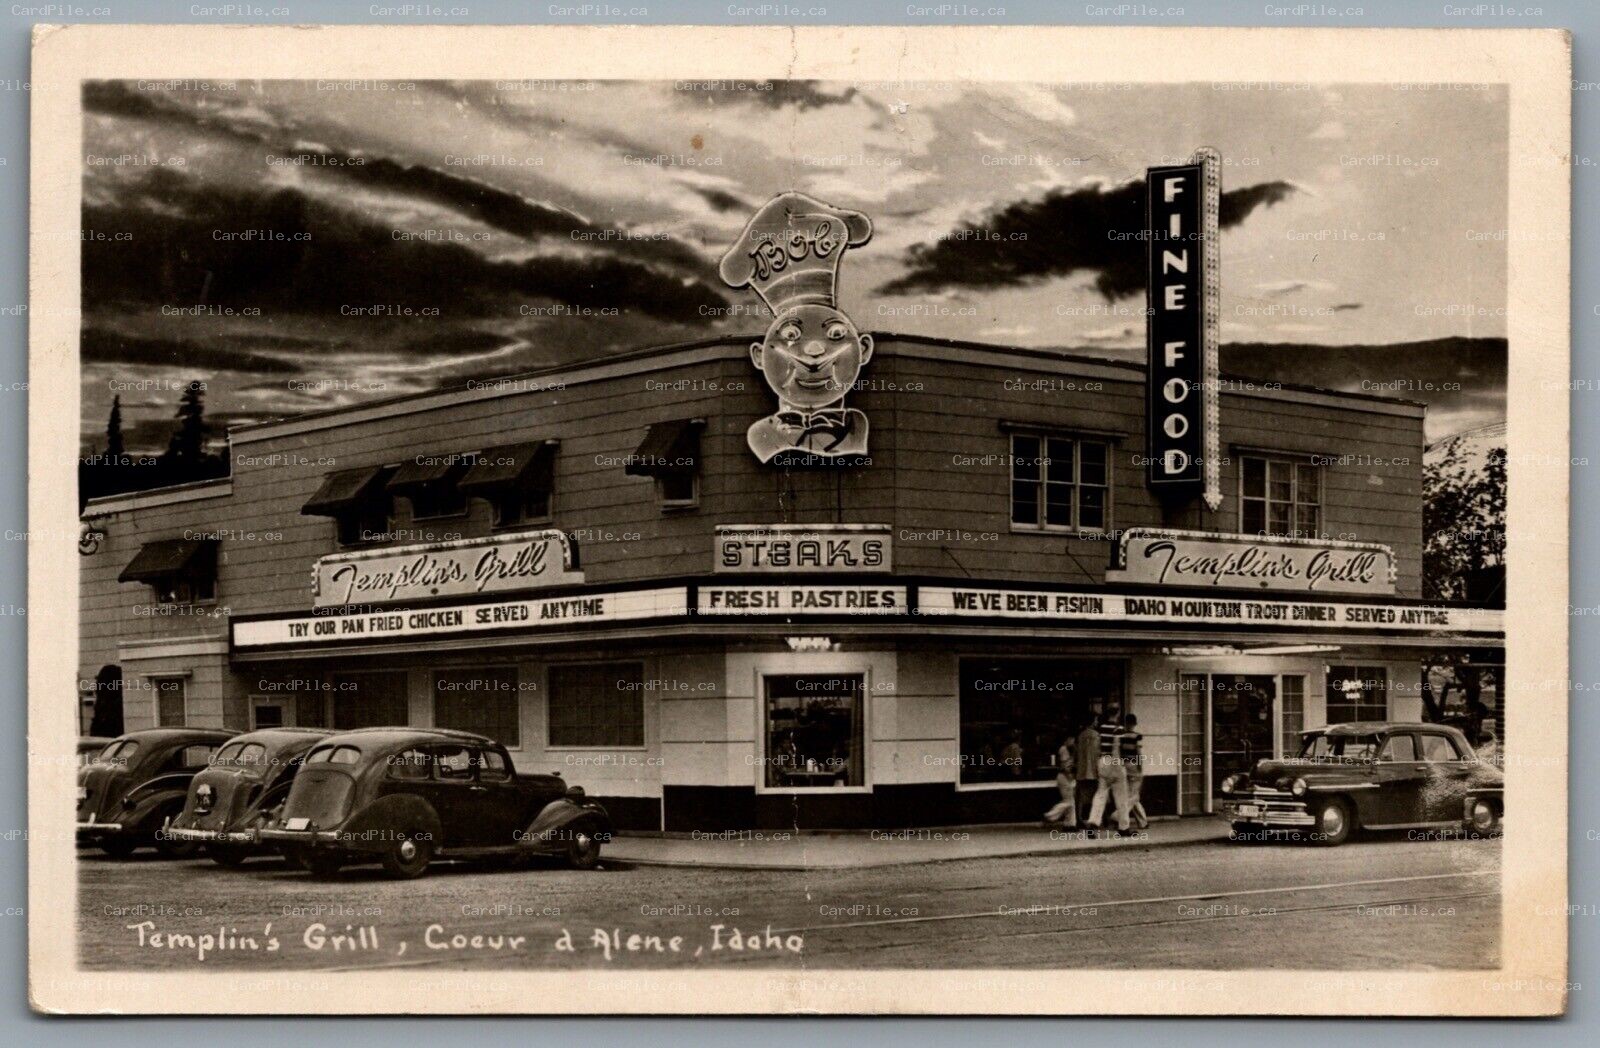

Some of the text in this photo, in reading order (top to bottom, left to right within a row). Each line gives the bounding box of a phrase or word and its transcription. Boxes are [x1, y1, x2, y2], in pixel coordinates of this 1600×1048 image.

[1163, 177, 1189, 475] FINE FOOD
[474, 541, 546, 593] Grill
[722, 540, 883, 567] STEAKS
[1144, 541, 1377, 590] Templin's Grill
[288, 623, 309, 638] TRY
[314, 620, 336, 636] OUR
[342, 618, 364, 634] PAN
[369, 615, 403, 632] FRIED
[408, 609, 463, 629] CHICKEN
[475, 605, 529, 624] SERVED
[540, 598, 604, 620] ANYTIME
[709, 590, 896, 609] FRESH PASTRIES
[1006, 593, 1048, 612] BEEN
[1056, 595, 1103, 614] FISHIN
[1124, 598, 1166, 616] IDAHO
[1245, 602, 1288, 620] TROUT
[1345, 607, 1395, 623] SERVED
[127, 921, 280, 961] Templin's
[424, 923, 526, 951] Coeur
